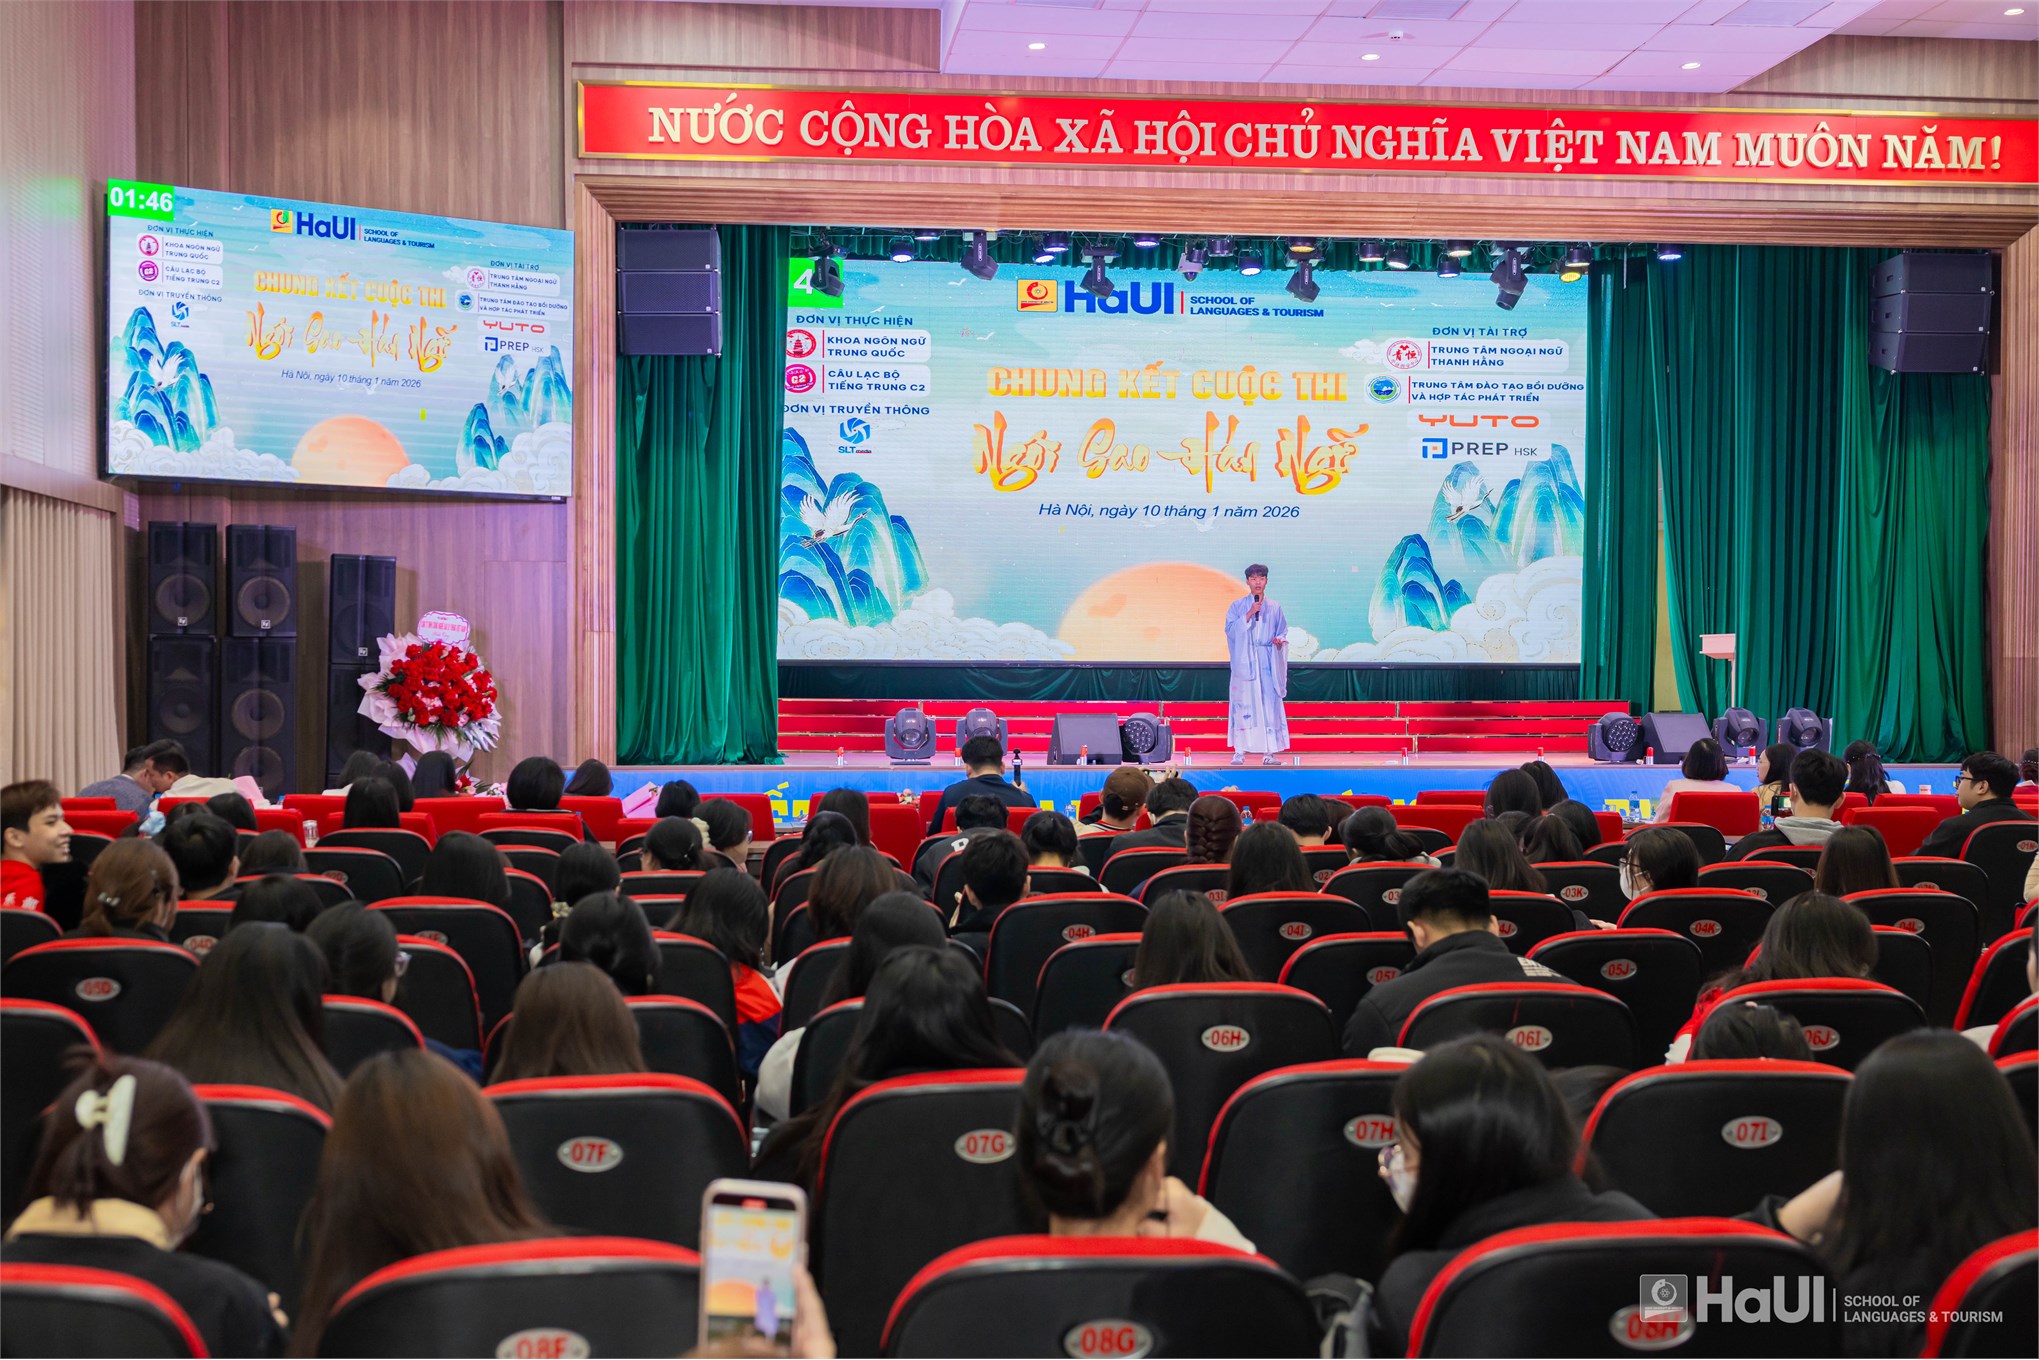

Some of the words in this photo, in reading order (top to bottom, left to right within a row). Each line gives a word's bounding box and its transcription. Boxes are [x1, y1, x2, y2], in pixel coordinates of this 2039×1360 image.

[648, 92, 784, 145] NƯỚC
[800, 101, 932, 157] CỘNG
[944, 102, 1041, 154] HÒA
[1054, 109, 1124, 156] XÃ
[1133, 110, 1216, 164] HỘI
[1224, 108, 1322, 160] CHỦ
[1332, 117, 1482, 164] NGHĨA
[1490, 119, 1604, 172] VIỆT
[1614, 130, 1720, 167] NAM
[1734, 123, 1872, 170] MUÔN
[1881, 124, 2004, 171] NĂM!
[110, 187, 173, 212] 01:46
[296, 211, 356, 240] HaUI
[364, 228, 389, 237] SCHOOL
[364, 236, 401, 245] LANGUAGES
[407, 240, 435, 249] TOURISM
[254, 269, 320, 297] CHUNG
[325, 272, 360, 300] KẾT
[364, 279, 413, 308] CUỘC
[417, 286, 447, 308] THI
[1065, 280, 1174, 314] HaUI
[1190, 296, 1236, 306] SCHOOL
[1240, 297, 1255, 306] OF
[1190, 306, 1259, 317] LANGUAGES
[1262, 307, 1270, 316] &
[1272, 308, 1324, 317] TOURISM
[483, 320, 545, 333] YUTO
[796, 314, 825, 324] ĐƠN
[828, 316, 841, 326] VỊ
[845, 315, 882, 327] THỰC
[884, 315, 913, 328] HIỆN
[1432, 326, 1459, 336] ĐƠN
[1463, 328, 1475, 338] VỊ
[1480, 326, 1499, 337] TÀI
[1502, 327, 1528, 338] TRỢ
[499, 340, 530, 352] PREP
[827, 336, 860, 344] KHOA
[865, 335, 897, 345] NGÔN
[901, 336, 927, 346] NGỮ
[828, 348, 868, 357] TRUNG
[871, 347, 905, 358] QUỐC
[1431, 346, 1469, 354] TRUNG
[1474, 345, 1496, 354] TÂM
[1500, 347, 1537, 357] NGOẠI
[1539, 346, 1564, 356] NGỮ
[1431, 358, 1470, 366] THANH
[1473, 355, 1505, 367] HẰNG
[828, 369, 854, 378] CÂU
[856, 371, 881, 380] LẠC
[884, 370, 900, 381] BỘ
[828, 380, 863, 390] TIẾNG
[867, 383, 907, 391] TRUNG
[987, 366, 1107, 398] CHUNG
[1118, 361, 1180, 399] KẾT
[1192, 365, 1283, 406] CUỘC
[1293, 372, 1348, 402] THI
[1412, 381, 1448, 389] TRUNG
[1450, 381, 1474, 389] TÂM
[1476, 380, 1499, 390] ĐÀO
[1502, 382, 1524, 392] TẠO
[1411, 392, 1426, 401] VÀ
[1429, 393, 1450, 402] HỢP
[1454, 392, 1475, 401] TÁC
[1477, 392, 1507, 402] PHÁT
[812, 405, 825, 415] VỊ
[829, 403, 880, 415] TRUYỀN
[884, 405, 930, 415] THÔNG
[1418, 414, 1539, 428] YUTO
[971, 410, 1063, 492] Ngôi
[1077, 417, 1150, 478] Sao
[1156, 410, 1261, 493] Hán
[1275, 415, 1369, 495] Ngữ
[1452, 442, 1508, 455] PREP
[1514, 447, 1538, 456] HSK
[1039, 502, 1063, 516] Hà
[1066, 503, 1095, 518] Nội,
[1099, 505, 1140, 520] ngày
[1143, 504, 1159, 516] 10
[1164, 504, 1208, 520] tháng
[1213, 505, 1219, 517] 1
[1224, 505, 1258, 518] năm
[1262, 505, 1300, 518] 2026
[1565, 889, 1583, 897] 03K
[1069, 928, 1090, 938] 04H
[1287, 926, 1304, 936] 04I
[1695, 923, 1715, 934] 04K
[1608, 963, 1630, 976] 05J
[1210, 1030, 1241, 1046] 06H
[1516, 1030, 1542, 1046] 06I
[1804, 1029, 1831, 1047] 06J
[1355, 1120, 1395, 1141] 07H
[1738, 1121, 1768, 1141] 07I
[966, 1134, 1005, 1155] 07G
[571, 1141, 608, 1164] 07F
[1081, 1327, 1135, 1354] 08G
